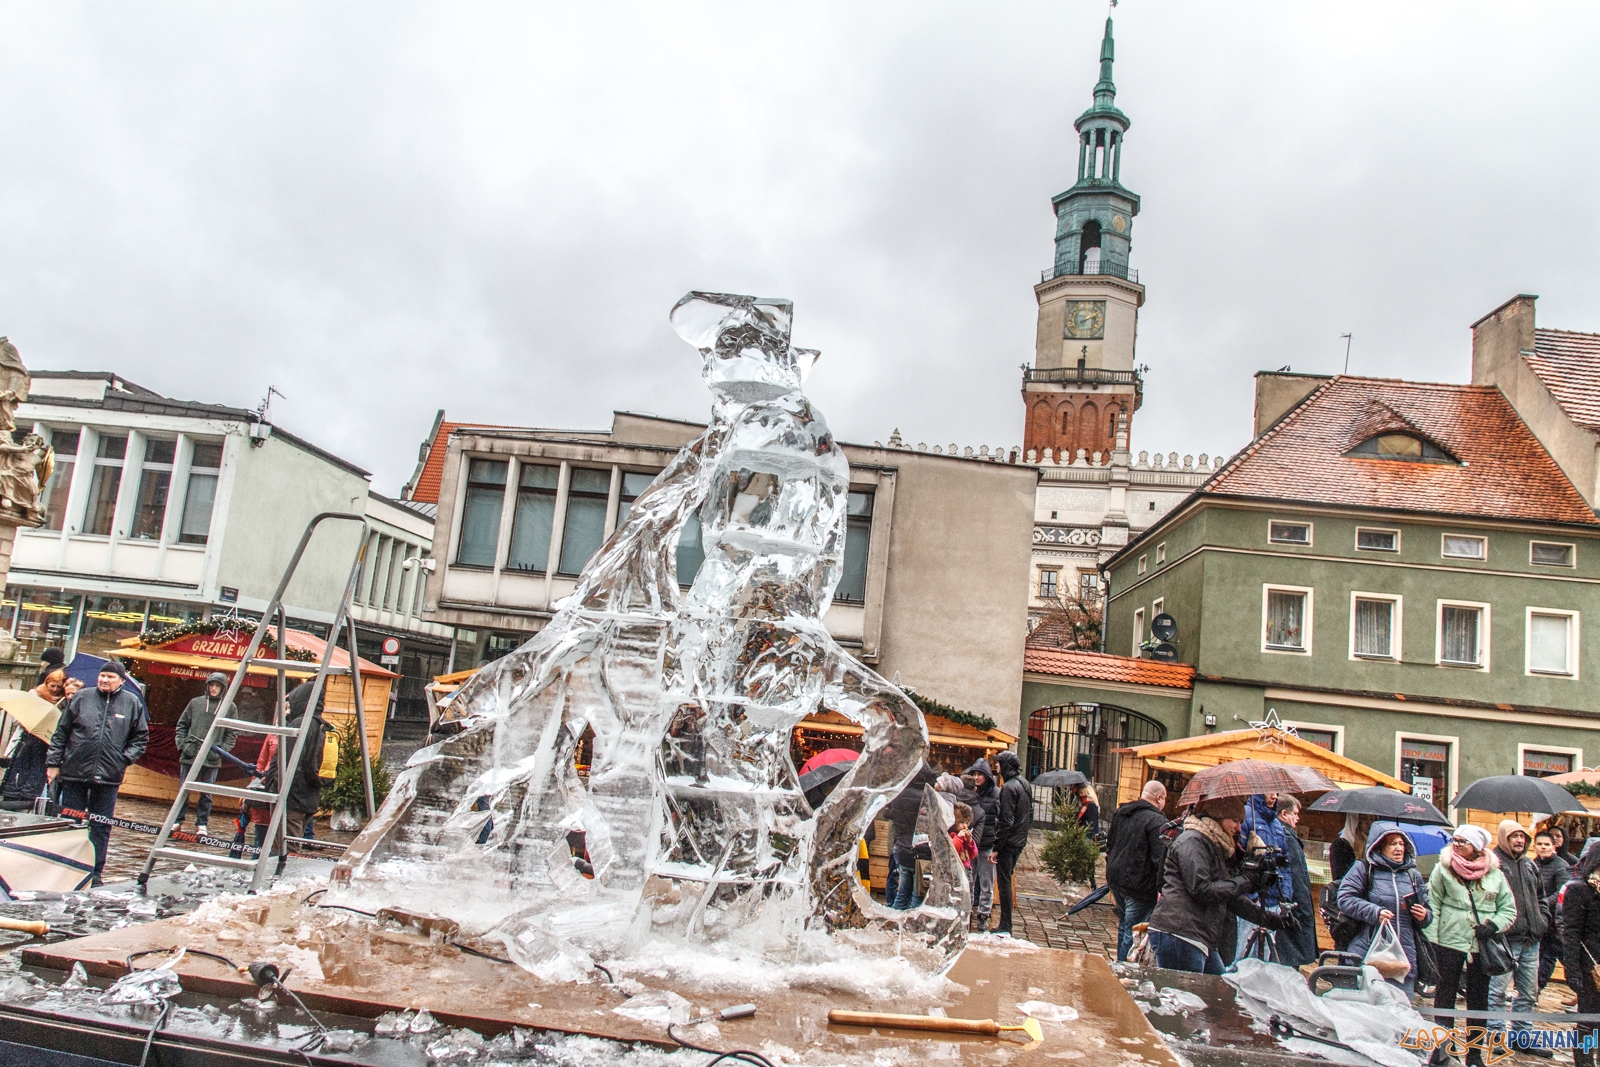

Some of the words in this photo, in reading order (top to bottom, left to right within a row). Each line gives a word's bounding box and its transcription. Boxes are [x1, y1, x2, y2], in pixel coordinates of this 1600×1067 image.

[192, 640, 235, 655] GRZANE
[170, 667, 194, 676] GRZANE
[61, 807, 87, 819] STIHL
[89, 813, 118, 826] POZnan
[119, 819, 130, 829] Ice
[130, 822, 158, 834] Festival
[171, 831, 197, 843] STIHL
[200, 836, 230, 849] POZnan
[231, 842, 242, 852] Ice
